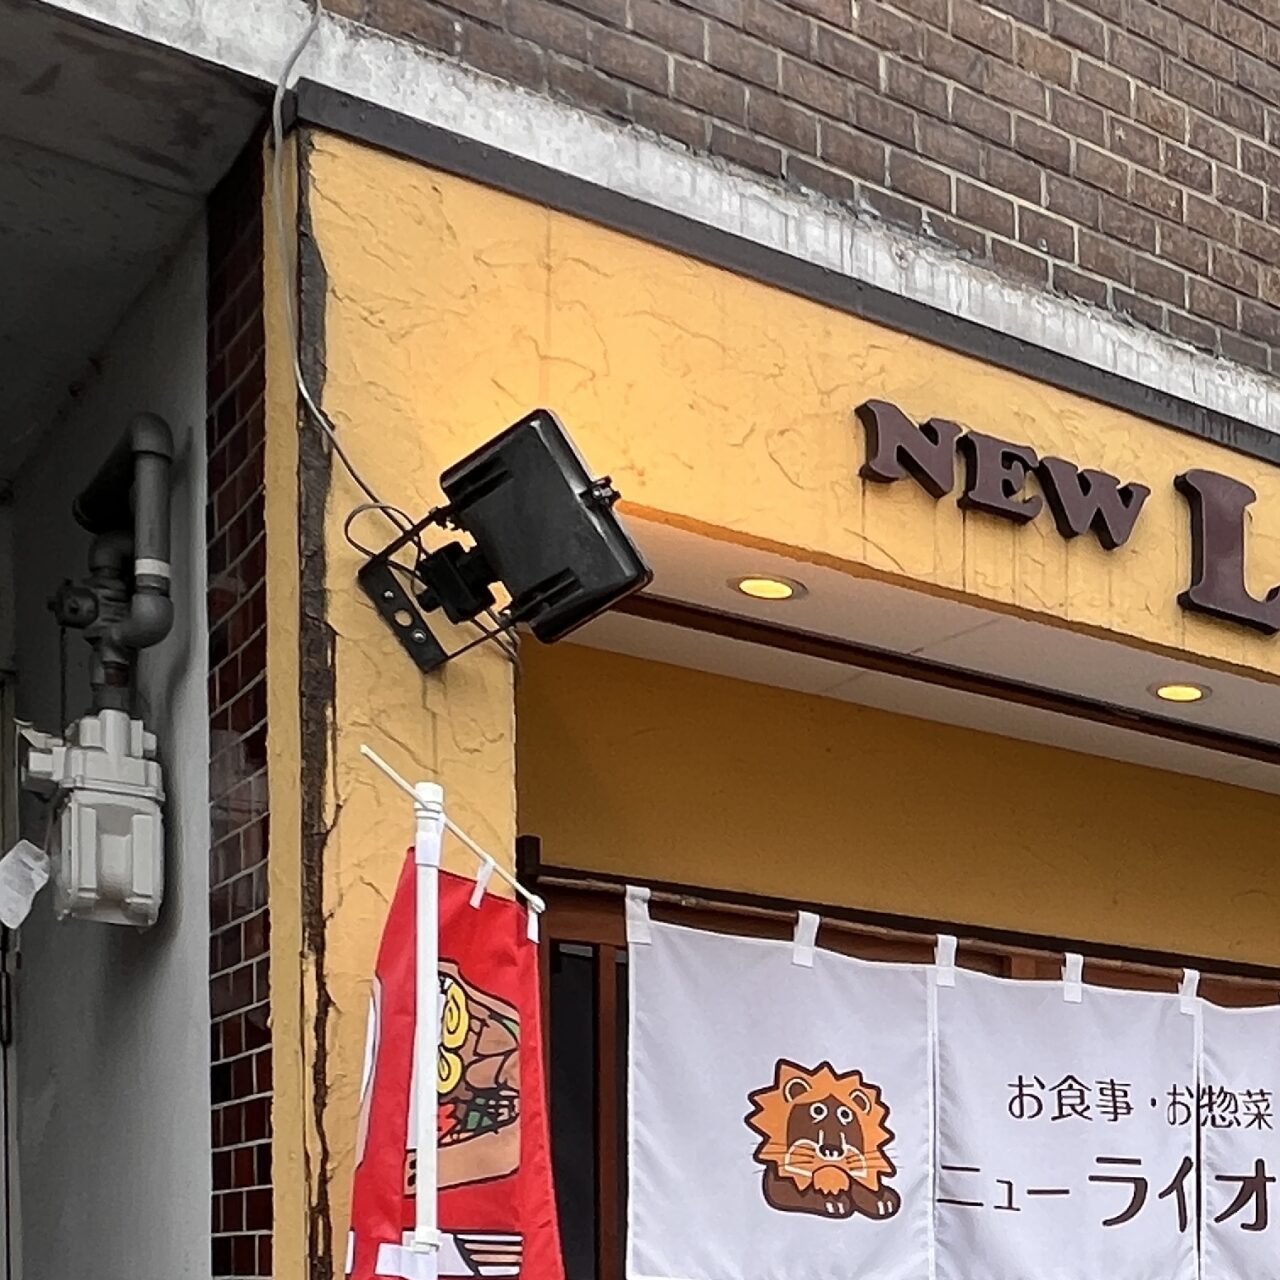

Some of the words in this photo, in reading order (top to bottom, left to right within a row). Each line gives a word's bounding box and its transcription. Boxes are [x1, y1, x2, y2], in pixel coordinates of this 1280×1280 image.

[855, 399, 1151, 551] NEW
[1006, 1074, 1274, 1131] お食事・お惣菜
